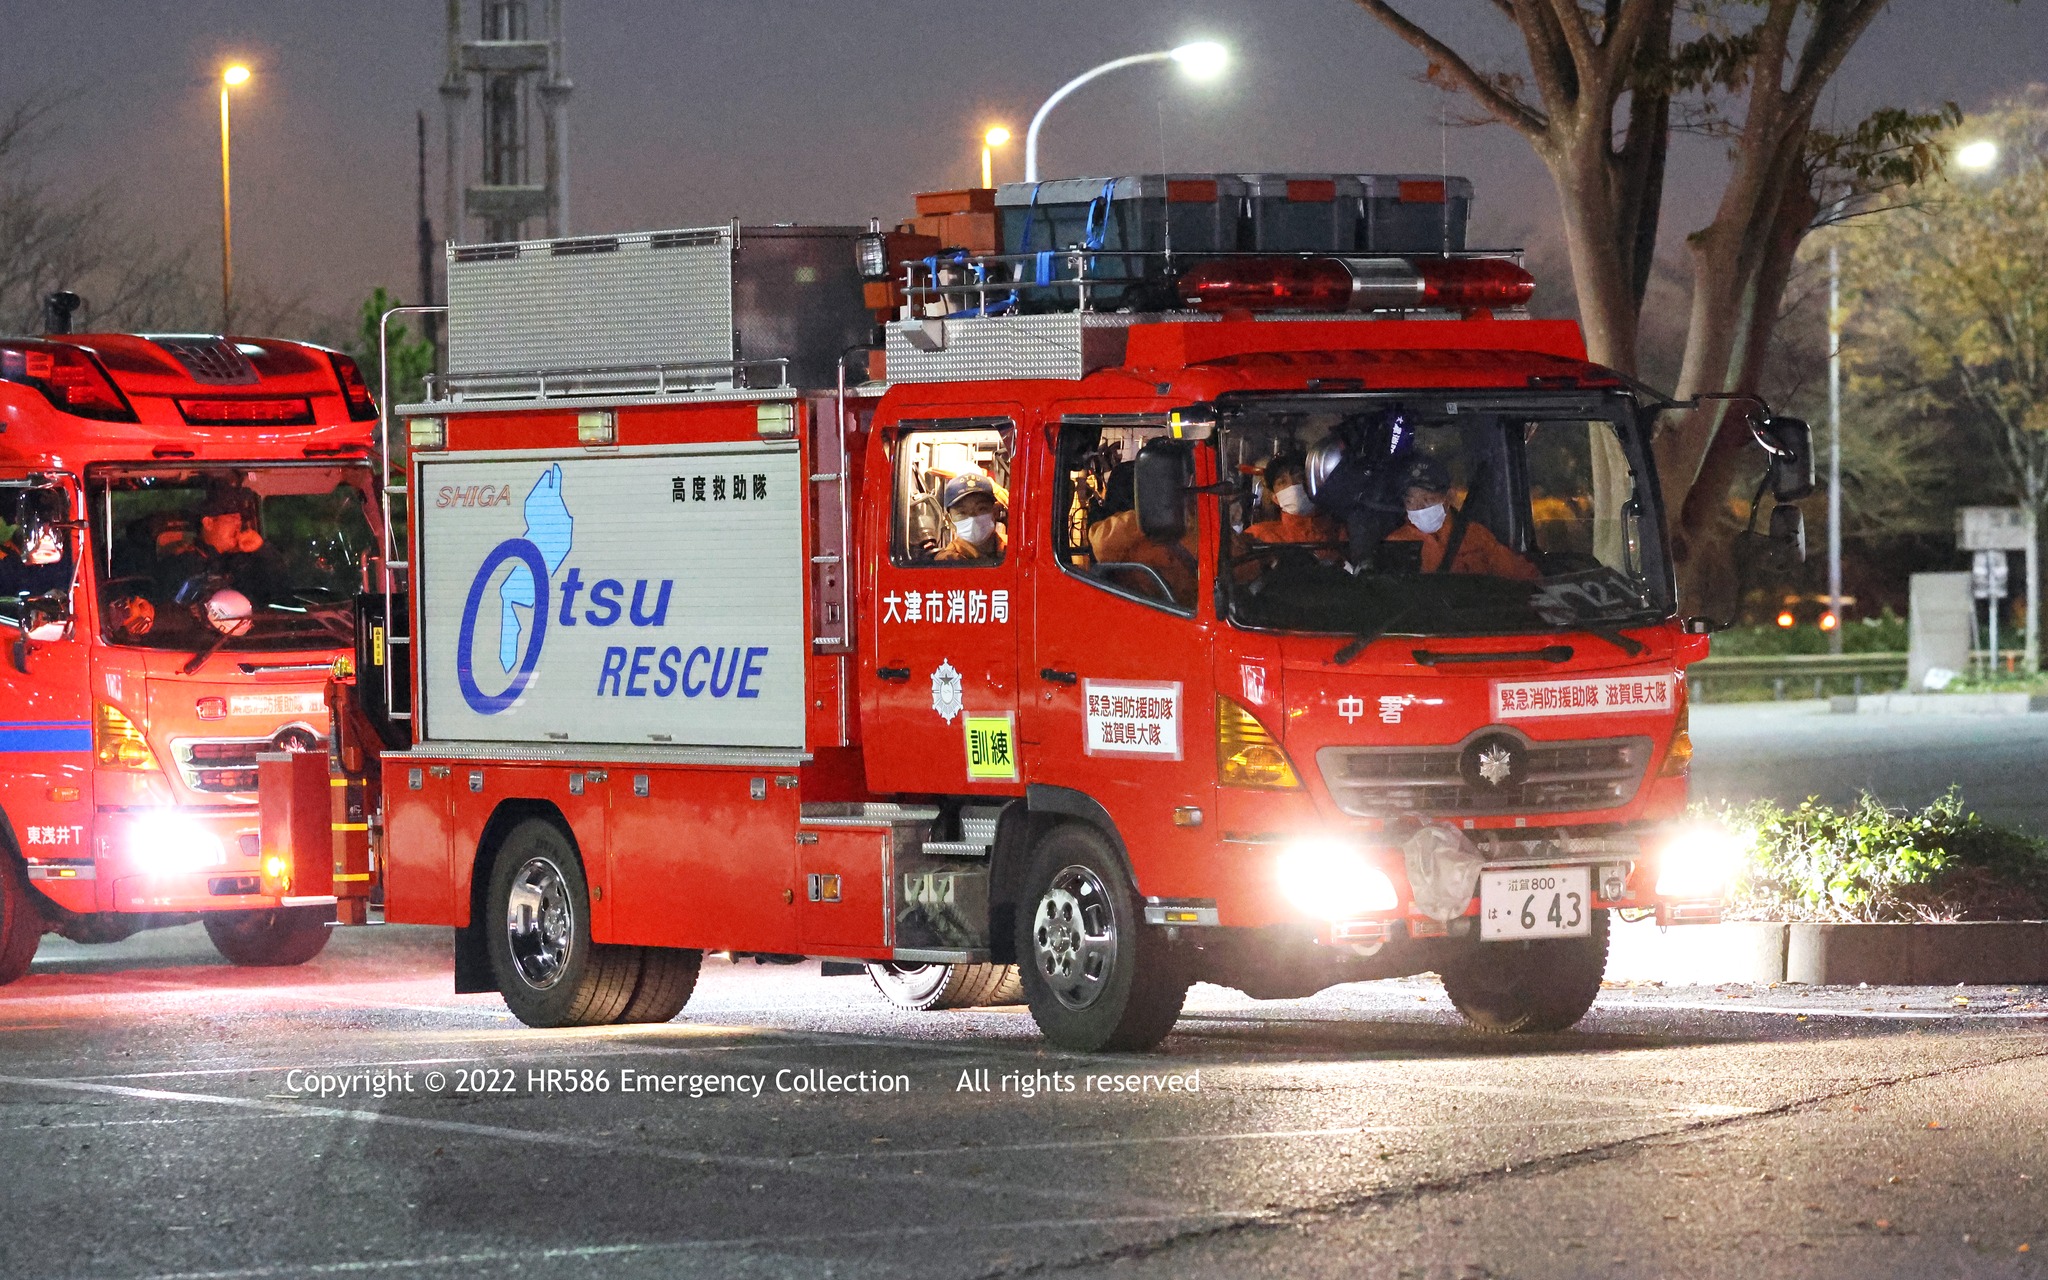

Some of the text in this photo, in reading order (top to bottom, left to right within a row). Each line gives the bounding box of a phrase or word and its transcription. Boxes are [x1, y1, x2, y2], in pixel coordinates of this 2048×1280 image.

[436, 485, 511, 508] SHIGA
[672, 474, 767, 502] 高度救助隊
[883, 590, 1009, 624] 大津市消防局
[597, 646, 769, 698] RESCUE
[1089, 695, 1173, 720] 緊急消防援助隊
[1501, 681, 1667, 711] 緊急消防援助隊 滋賀県大隊
[971, 730, 1010, 766] 訓練
[1101, 722, 1162, 746] 滋賀県大隊
[27, 825, 83, 845] 東浅井T
